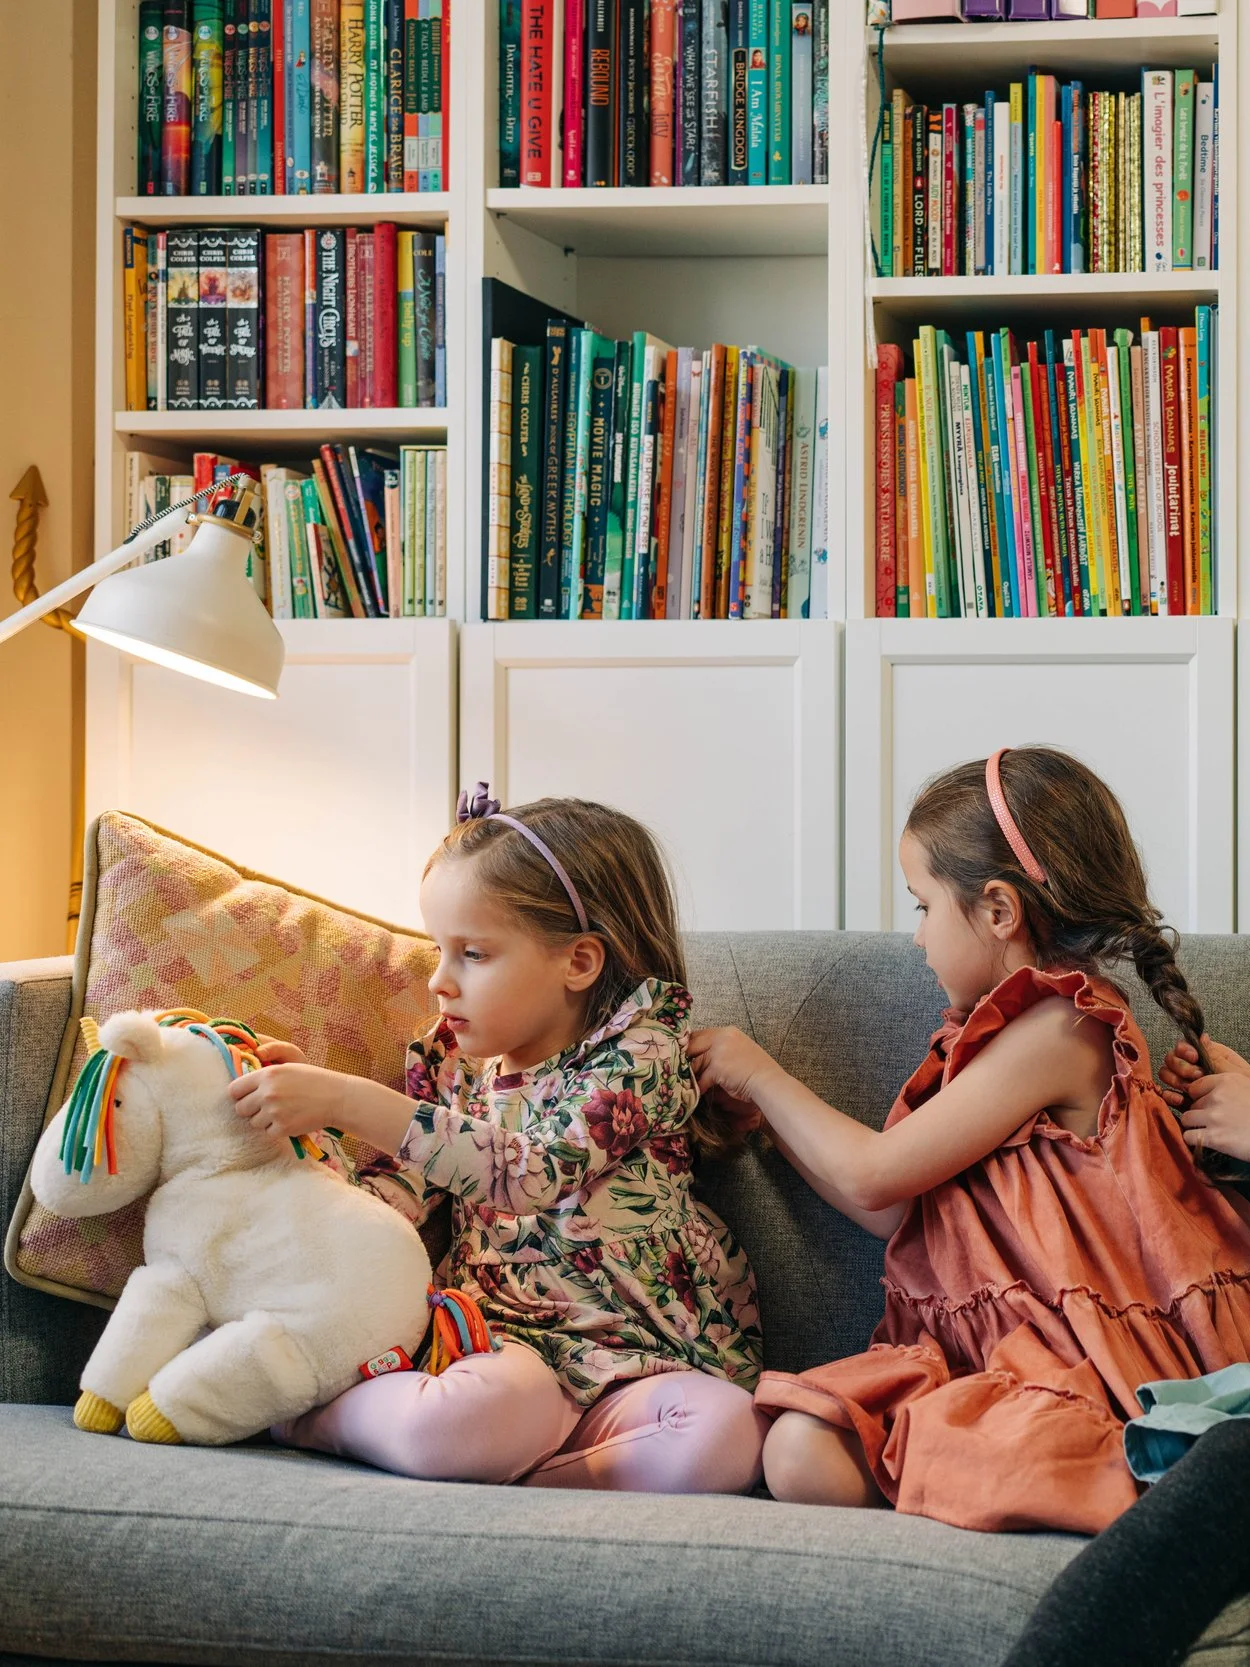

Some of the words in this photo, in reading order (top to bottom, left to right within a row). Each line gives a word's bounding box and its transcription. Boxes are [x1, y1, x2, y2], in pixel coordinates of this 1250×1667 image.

[529, 5, 544, 40] THE
[349, 18, 363, 67] HARRY
[685, 45, 696, 71] WHAT
[144, 51, 158, 87] WINGS
[390, 48, 402, 115] CLARICE
[506, 44, 516, 98] DAUGHTER
[528, 46, 543, 92] HATE
[590, 49, 610, 106] REBOUND
[685, 73, 696, 89] WE
[735, 62, 745, 105] BRIDGE
[349, 73, 364, 128] POTTER
[528, 98, 543, 109] U
[685, 90, 696, 106] SEE
[705, 49, 718, 129] STARFISH
[751, 89, 762, 108] Am
[146, 96, 159, 122] FIRE
[199, 96, 211, 122] FIRE
[369, 111, 377, 132] NAME
[1152, 92, 1164, 150] L'imagier
[506, 117, 516, 143] DEEP
[527, 116, 542, 159] GIVE
[627, 118, 636, 150] GREEK
[685, 121, 697, 150] STARS
[735, 108, 745, 165] KINGDOM
[750, 113, 764, 148] Malala
[369, 145, 377, 178] JESSICA
[390, 133, 402, 181] BRAVE
[626, 150, 636, 177] GODS
[1155, 156, 1165, 177] des
[1199, 135, 1209, 173] Bedtime
[914, 194, 923, 225] LORD
[1152, 182, 1165, 247] princesses
[322, 250, 334, 271] THE
[347, 244, 356, 288] BROTHERS
[914, 247, 923, 277] FLIES
[318, 308, 341, 348] CIRCUS
[347, 290, 356, 338] LIONHEART
[402, 302, 414, 330] belly
[402, 332, 412, 347] up
[521, 375, 529, 404] CHRIS
[1164, 365, 1174, 402] MAURI
[520, 407, 529, 443] COLFER
[566, 412, 576, 468] EGYPTIAN
[591, 417, 605, 458] MOVIE
[955, 422, 963, 452] MYYRÄ
[1165, 406, 1176, 453] KUNNAS
[800, 442, 809, 479] ASTRID
[880, 404, 890, 489] PRINSESSOJEN
[547, 456, 558, 498] GREEK
[590, 464, 603, 506] MAGIC
[642, 471, 652, 498] HOUSE
[545, 501, 557, 543] MYTHS
[562, 473, 574, 547] MYTHOLOGY
[642, 502, 651, 512] IS
[797, 483, 808, 549] LINDGRENIN
[640, 531, 649, 549] FIRE
[880, 493, 891, 562] SATUAARRE
